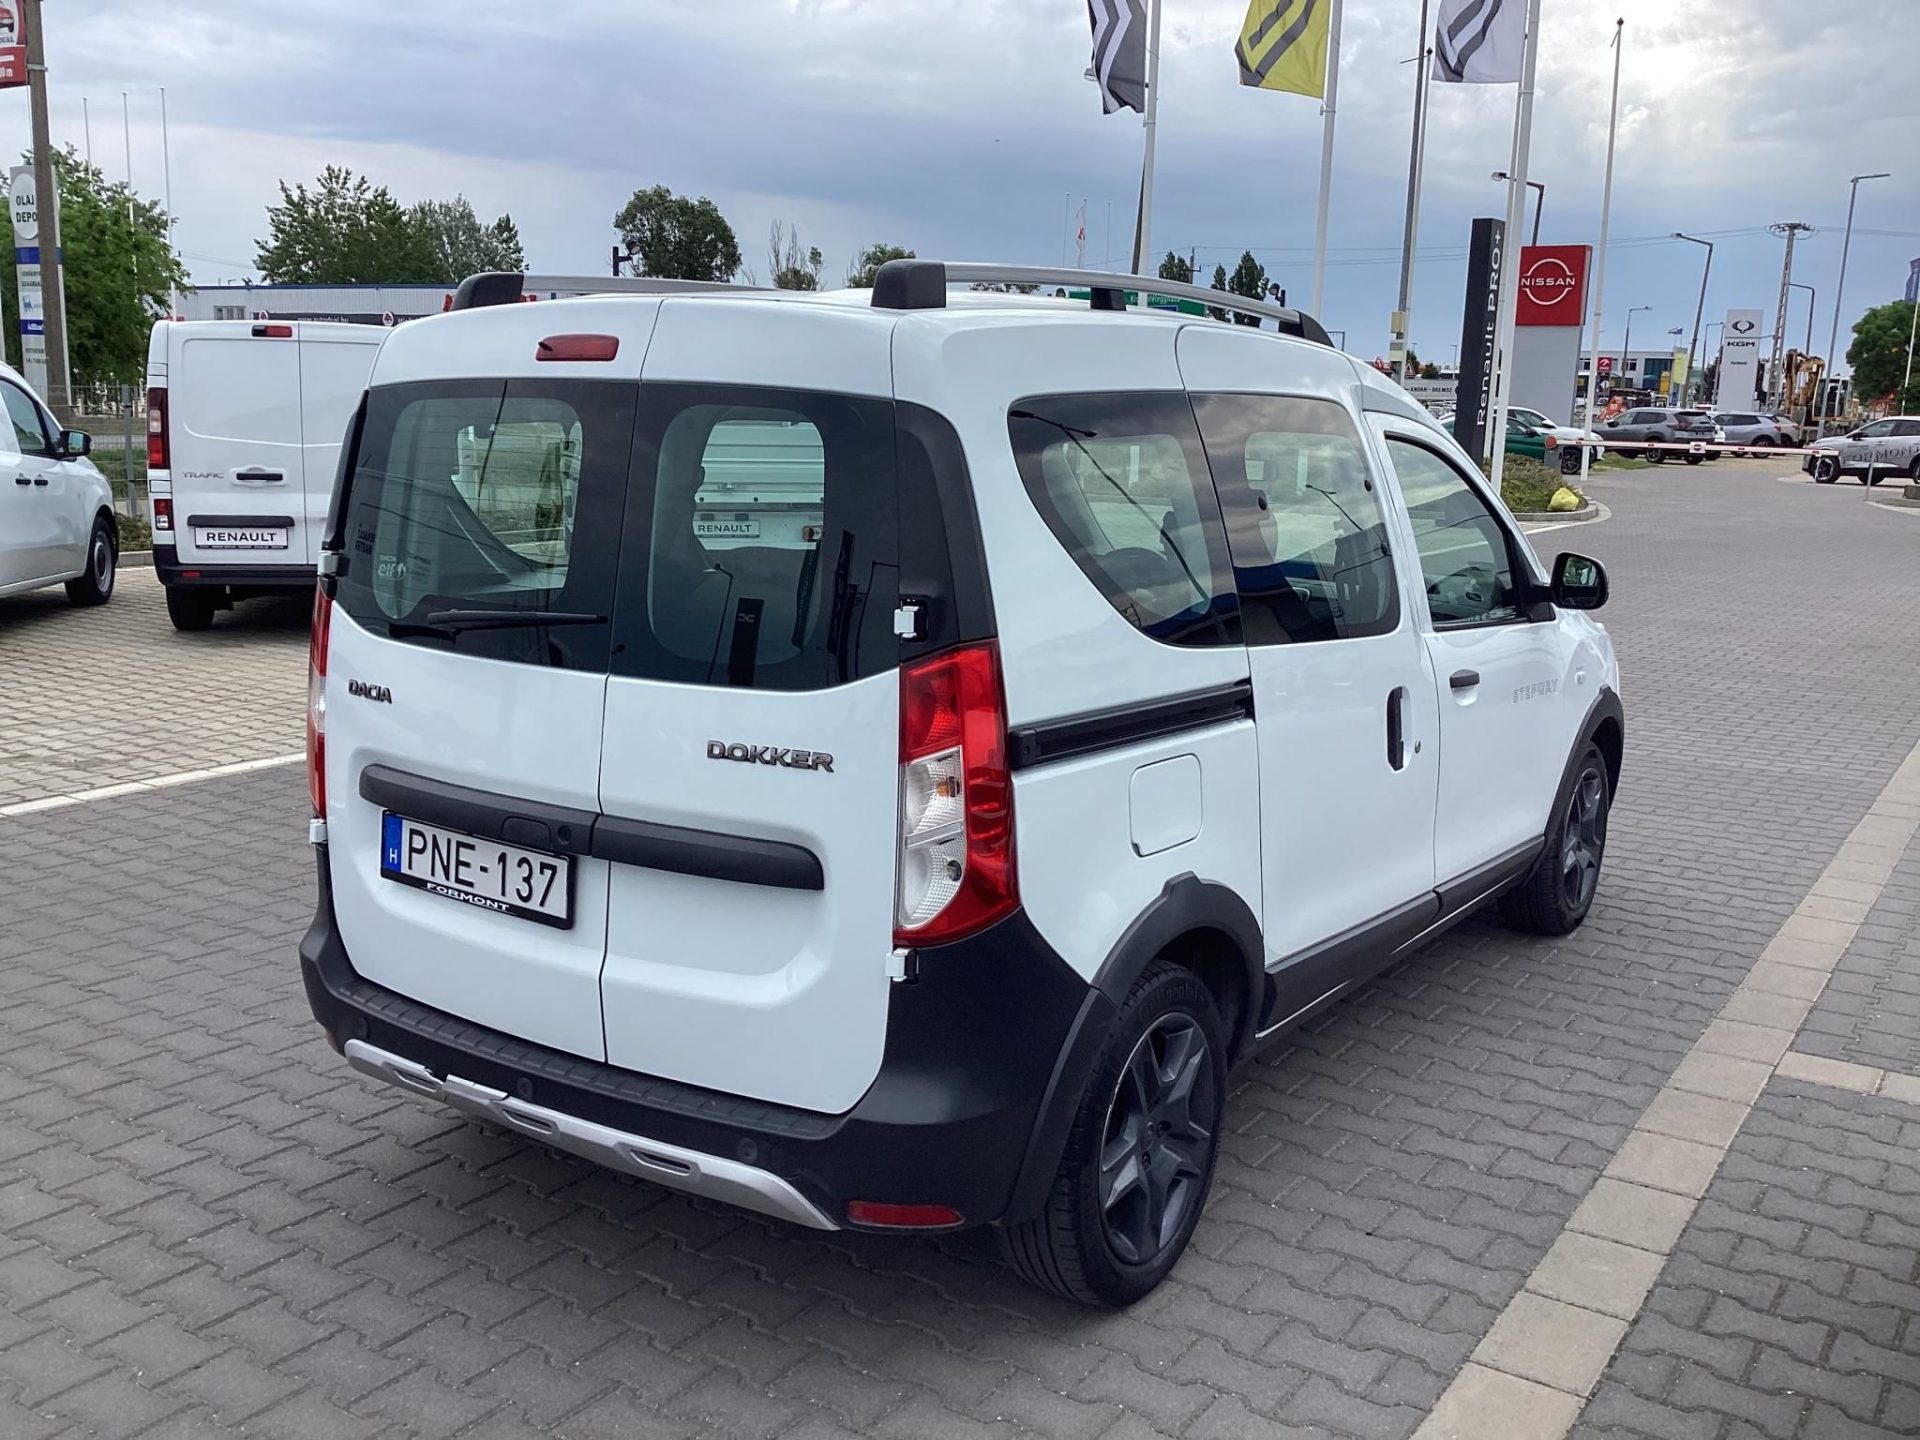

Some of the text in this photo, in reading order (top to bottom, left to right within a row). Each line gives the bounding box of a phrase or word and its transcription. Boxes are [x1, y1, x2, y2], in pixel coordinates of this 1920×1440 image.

[15, 194, 35, 206] OLAJ
[1520, 277, 1576, 286] NISSAN
[1476, 229, 1502, 426] Renault PRO+
[206, 532, 277, 542] RENAULT
[697, 524, 752, 533] RENAULT
[348, 678, 393, 704] DACIA
[707, 740, 835, 773] DOKKER
[389, 827, 558, 908] H PNE-137
[426, 882, 510, 912] FORMONT
